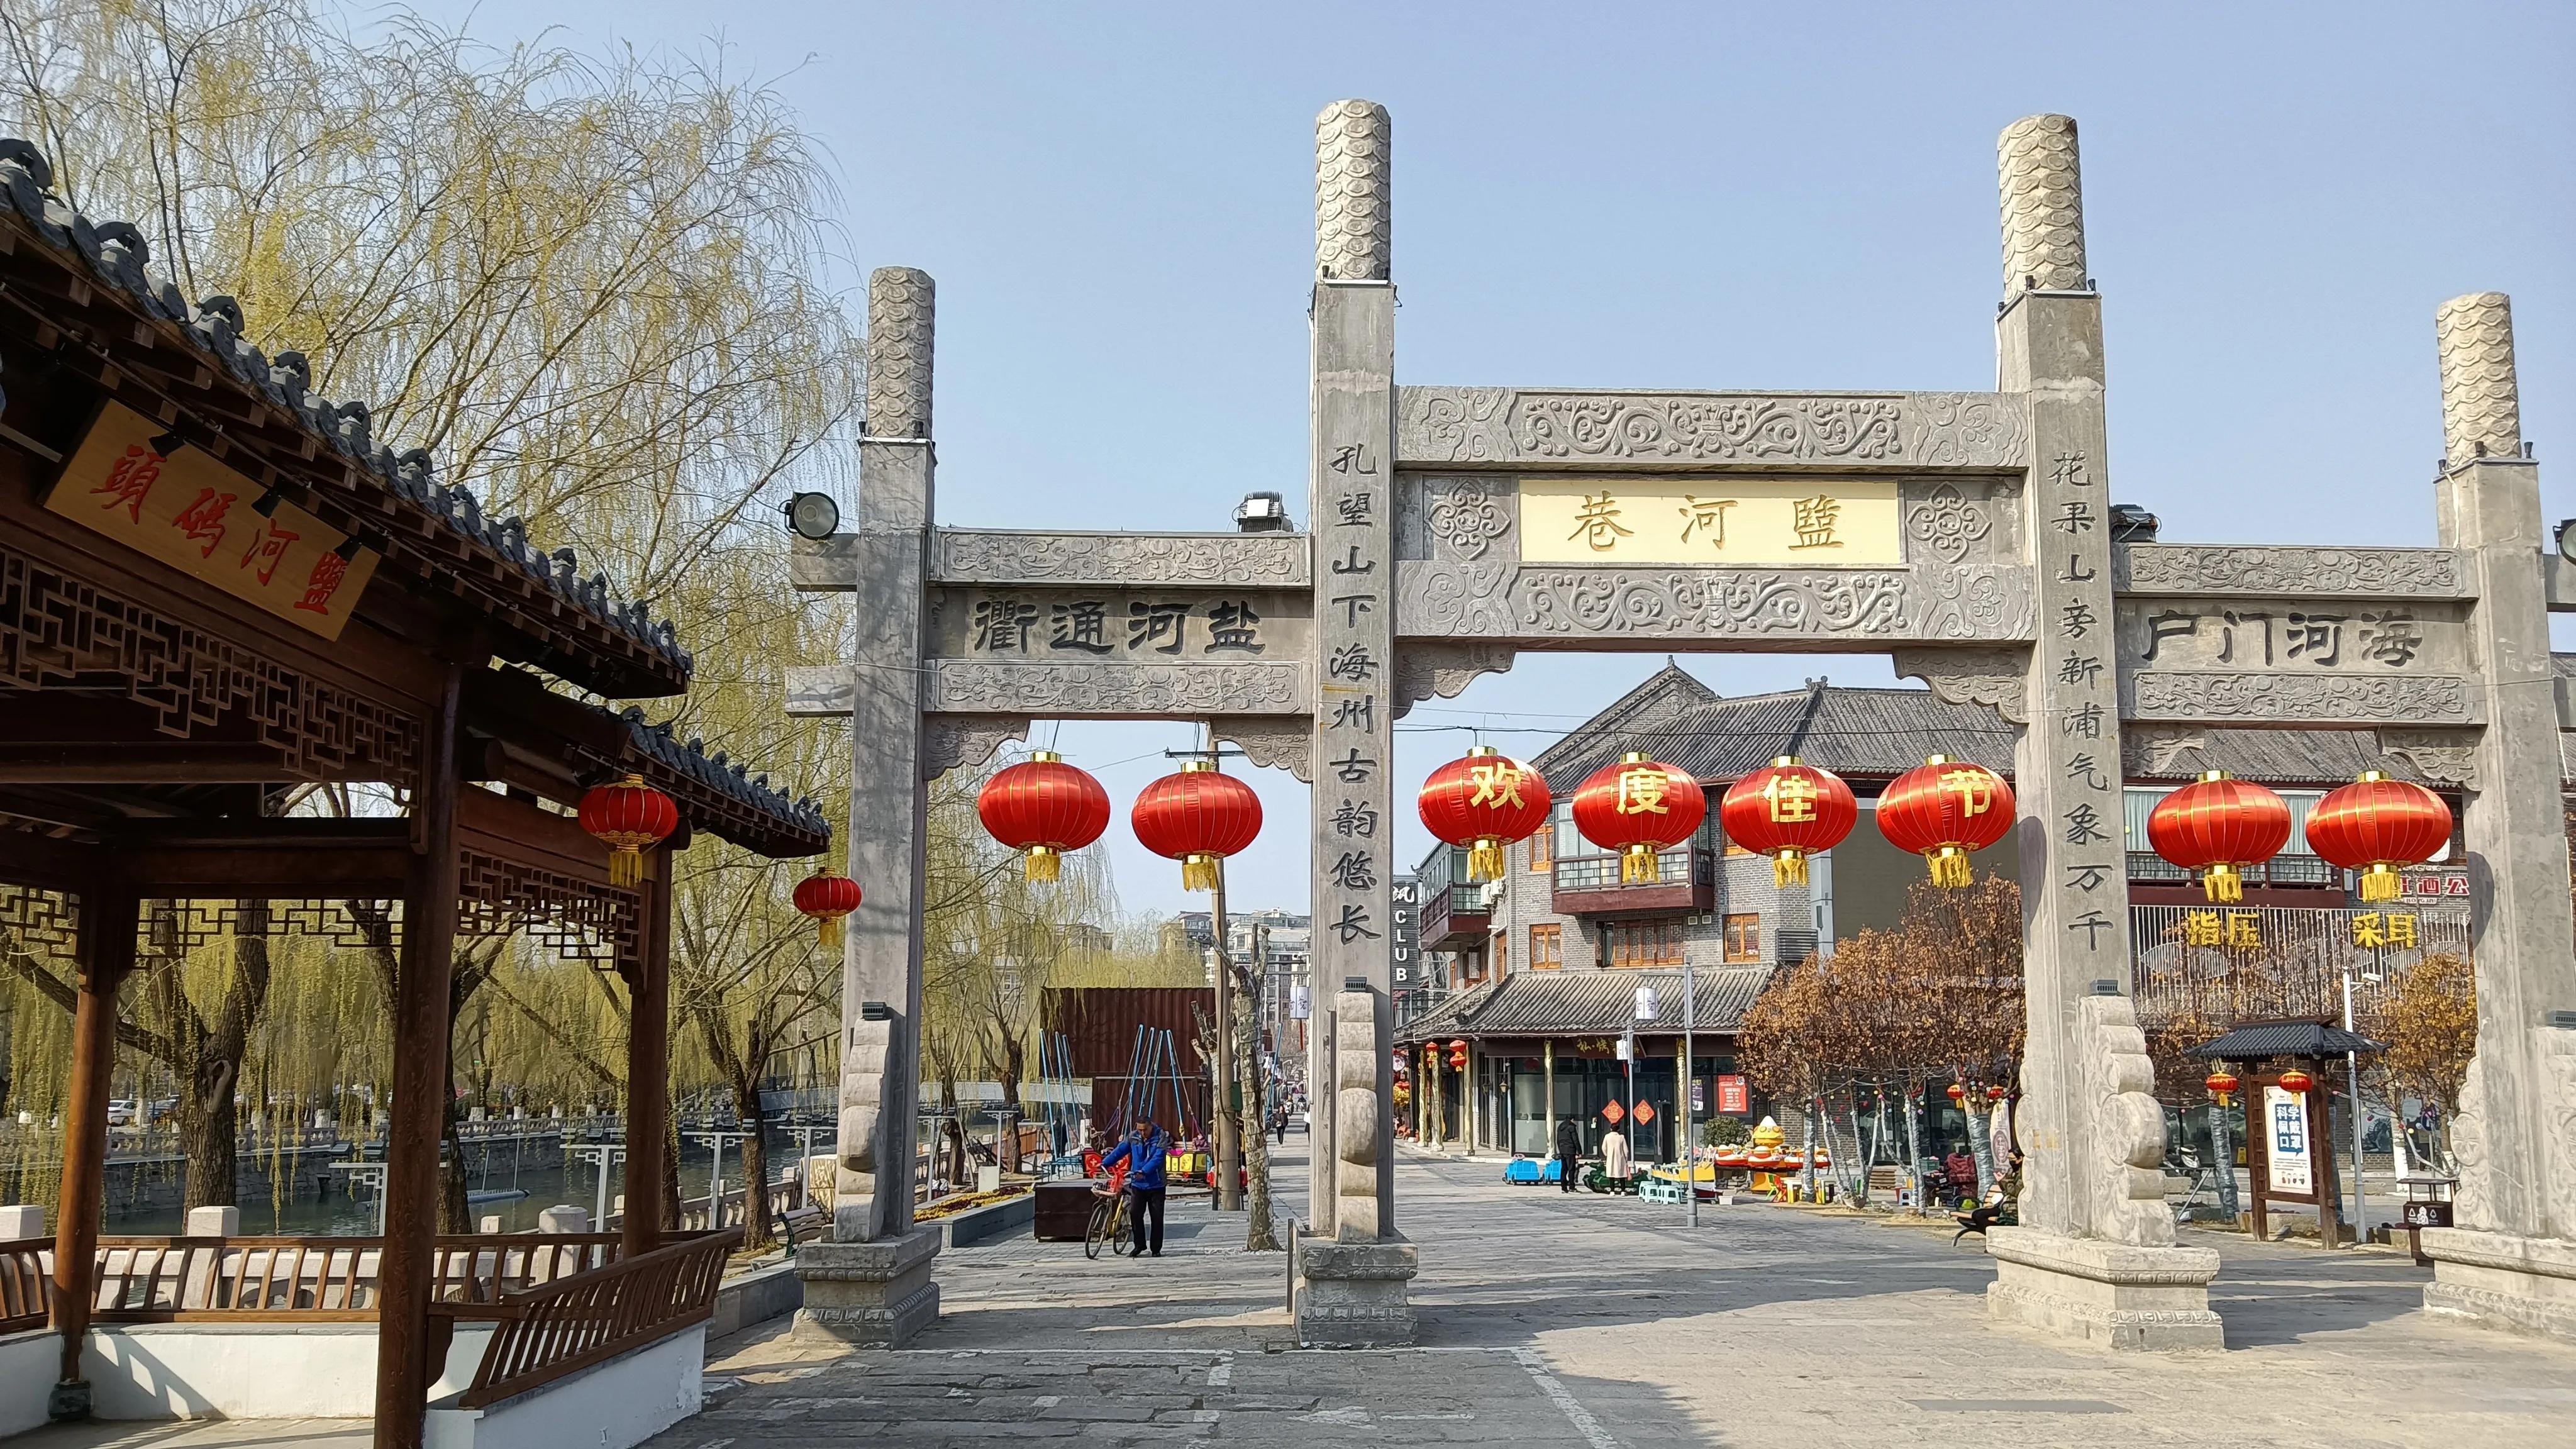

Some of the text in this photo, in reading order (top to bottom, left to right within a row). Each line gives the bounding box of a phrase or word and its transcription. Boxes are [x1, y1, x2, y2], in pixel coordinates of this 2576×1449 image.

[1329, 443, 1382, 944] 孔望山下海州古韵悠长
[2048, 449, 2114, 951] 花果山旁新浦气象万千
[1395, 910, 1407, 981] CLUB
[2353, 913, 2417, 948] 采耳
[2277, 1106, 2299, 1120] 科学
